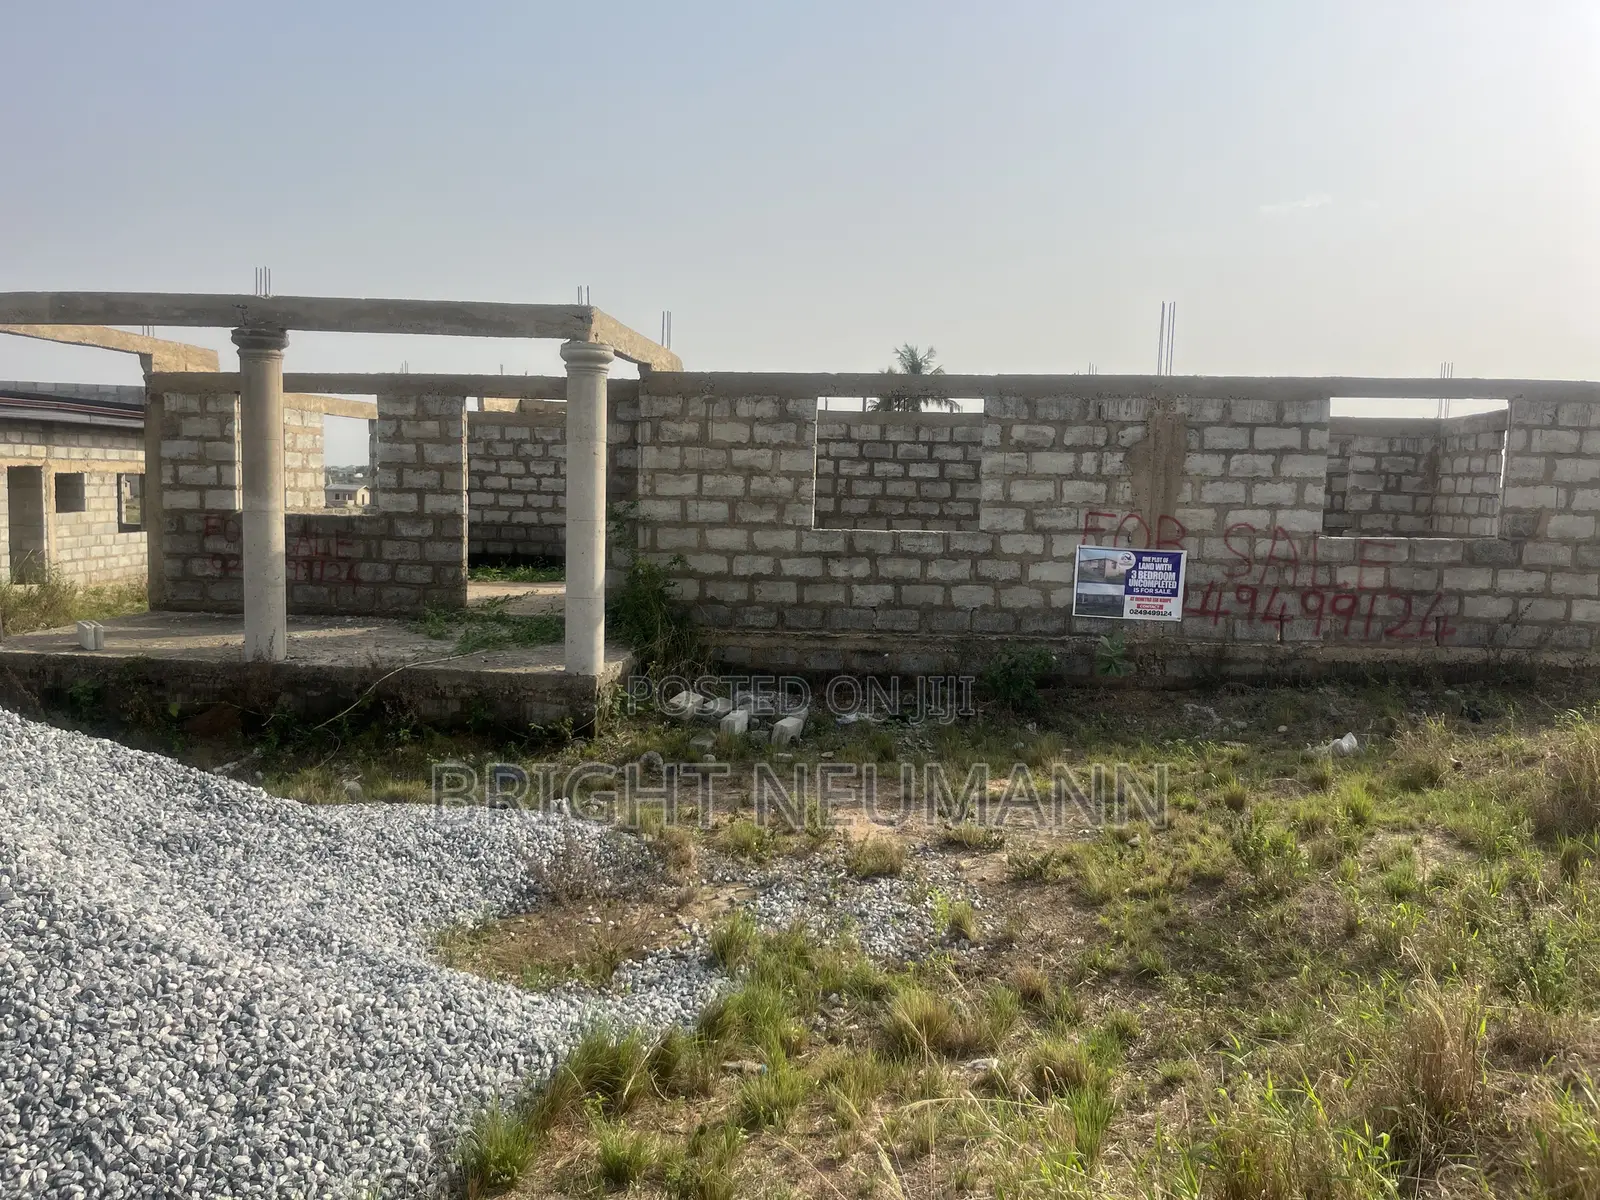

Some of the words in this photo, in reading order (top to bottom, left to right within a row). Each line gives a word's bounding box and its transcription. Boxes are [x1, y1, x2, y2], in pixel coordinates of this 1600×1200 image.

[1082, 511, 1187, 551] FOR
[1223, 522, 1396, 592] SALE
[1138, 562, 1154, 570] LAND
[1155, 563, 1173, 571] WITH
[1131, 570, 1137, 579] 3
[1138, 570, 1176, 581] BEDROOM
[1128, 578, 1177, 589] UNCOMPLETED
